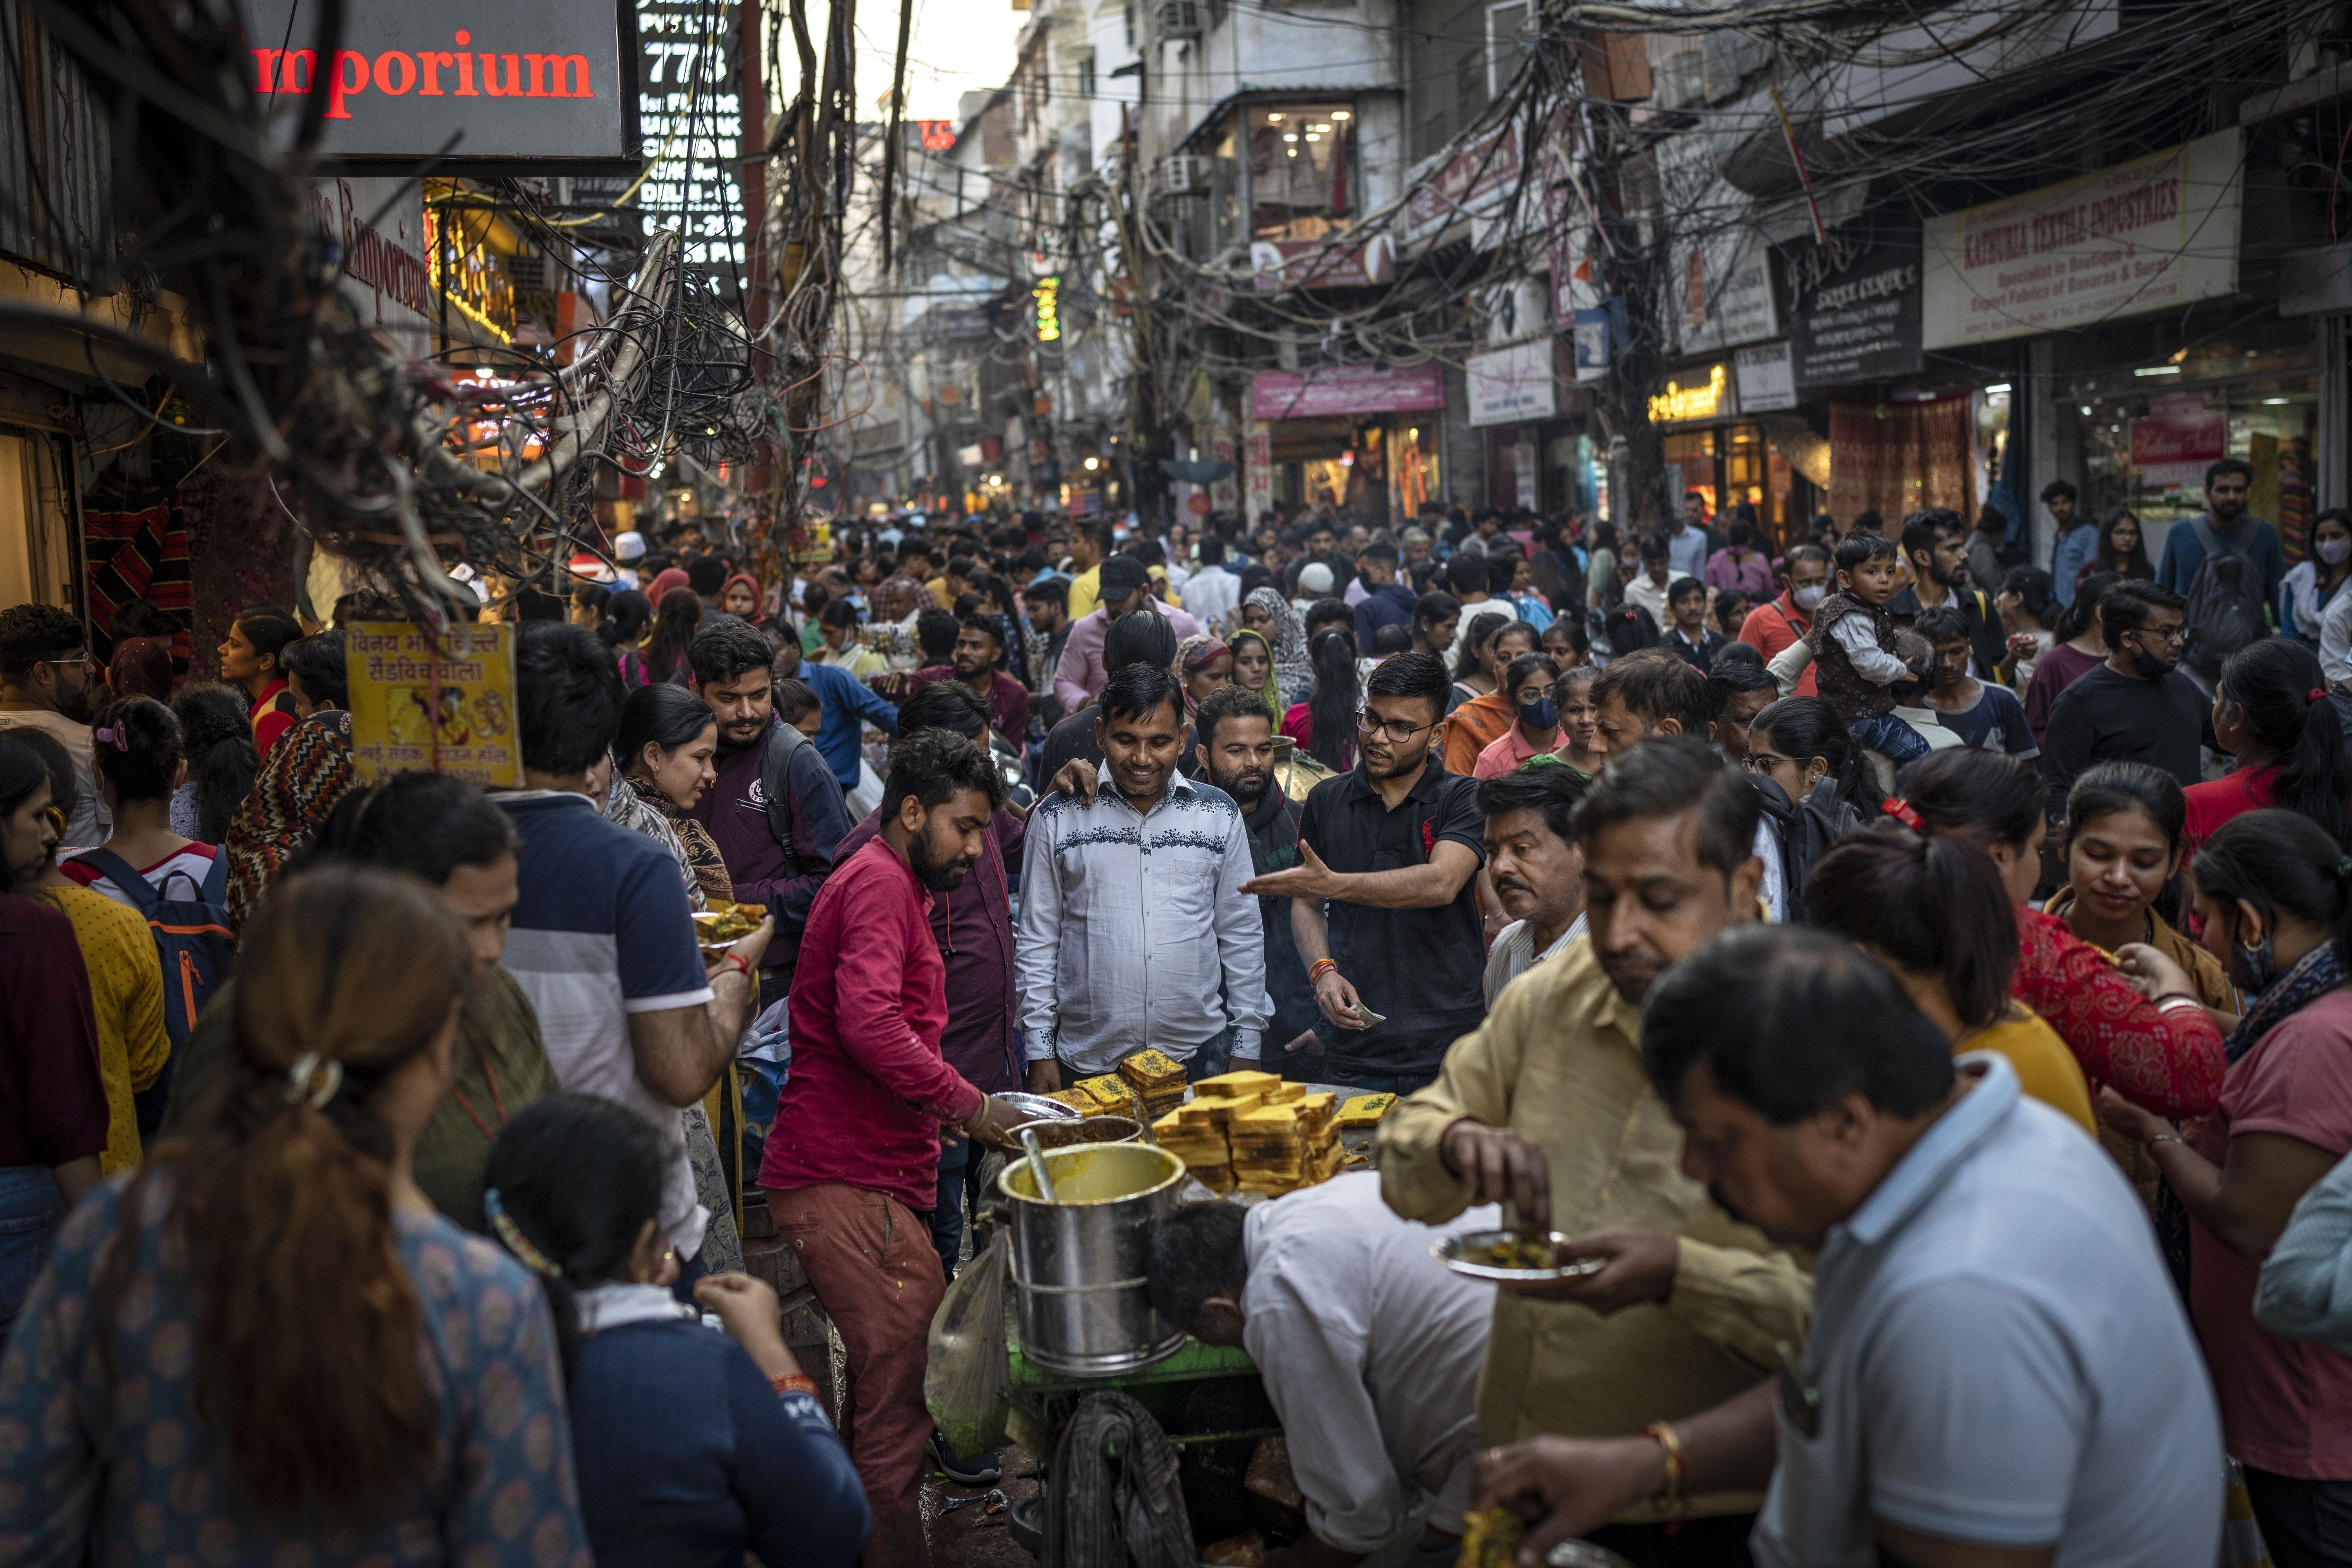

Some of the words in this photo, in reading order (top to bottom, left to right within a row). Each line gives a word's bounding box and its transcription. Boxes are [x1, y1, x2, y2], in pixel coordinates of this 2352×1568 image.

[251, 29, 595, 118] mporium
[1964, 222, 2028, 271] KATHURIA
[2032, 205, 2086, 253] TEXTILE
[2091, 178, 2178, 239] INDUSTRIES
[1998, 263, 2052, 289] Specialist
[2054, 261, 2065, 274] in
[2069, 250, 2122, 271] Boutique
[2009, 288, 2050, 305] Fabrics
[2053, 279, 2064, 295] of
[2068, 272, 2116, 292] Banaras
[351, 627, 399, 653] विनय
